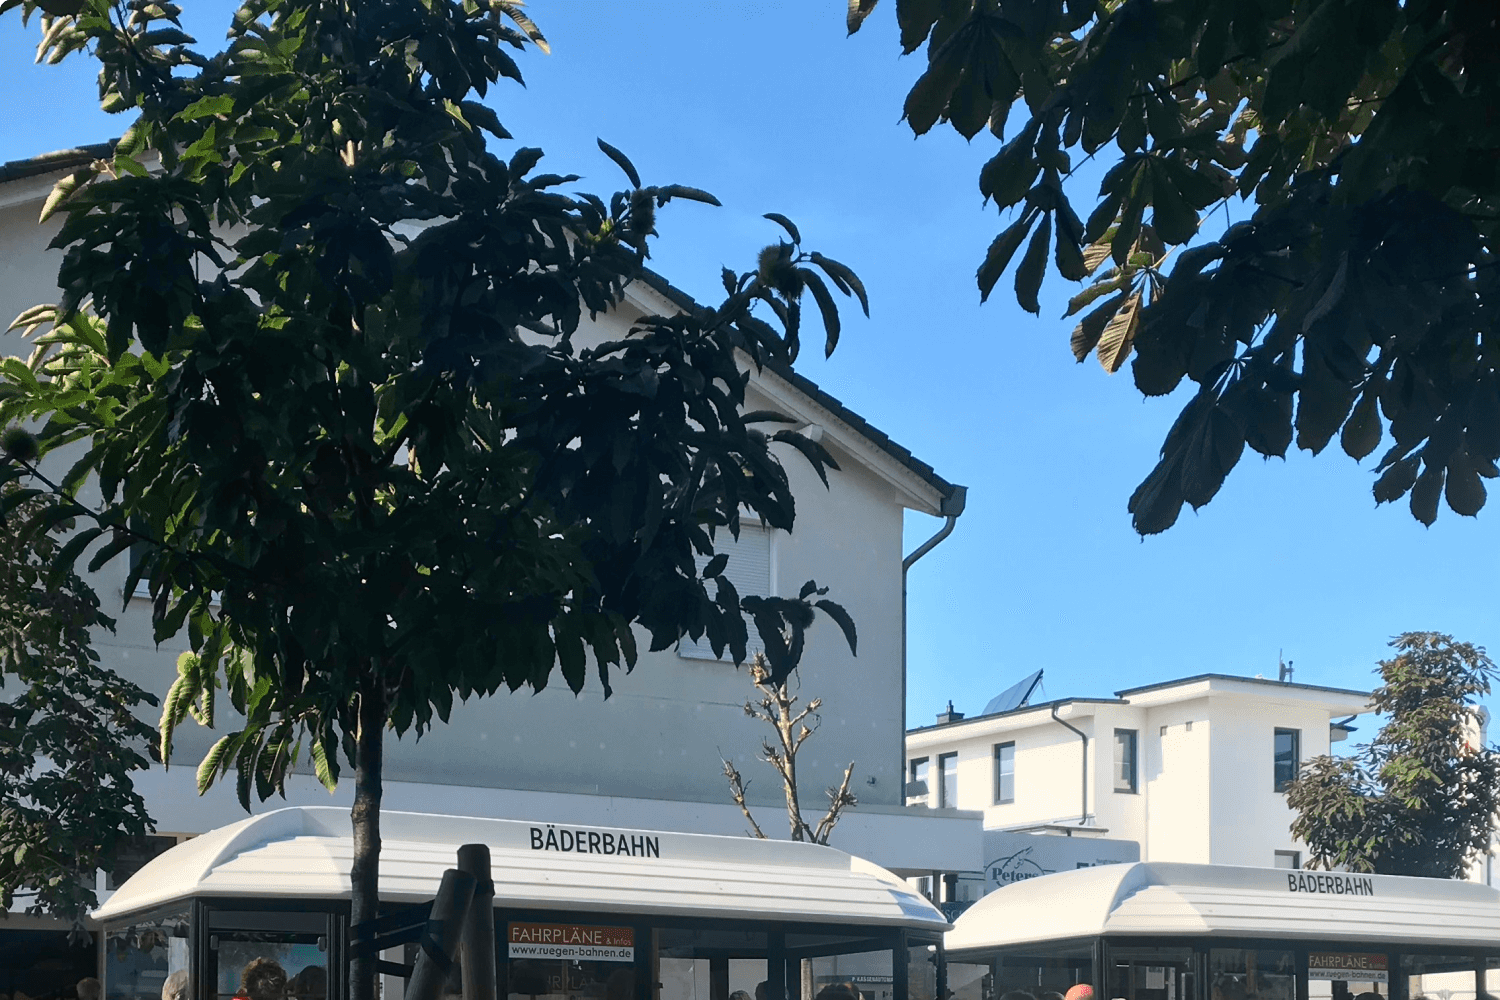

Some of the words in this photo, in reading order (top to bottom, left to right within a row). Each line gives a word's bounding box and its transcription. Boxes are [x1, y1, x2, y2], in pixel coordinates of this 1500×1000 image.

[530, 824, 660, 859] BÄDERBAHN
[1287, 870, 1374, 897] BÄDERBAHN
[511, 926, 602, 945] FAHRPLÄNE
[613, 937, 632, 946] Infos
[511, 945, 632, 959] www.ruegen-bahnen.de
[1309, 954, 1367, 969] FAHRPLÄNE
[1309, 969, 1386, 980] www.ruegen-bahnen.de
